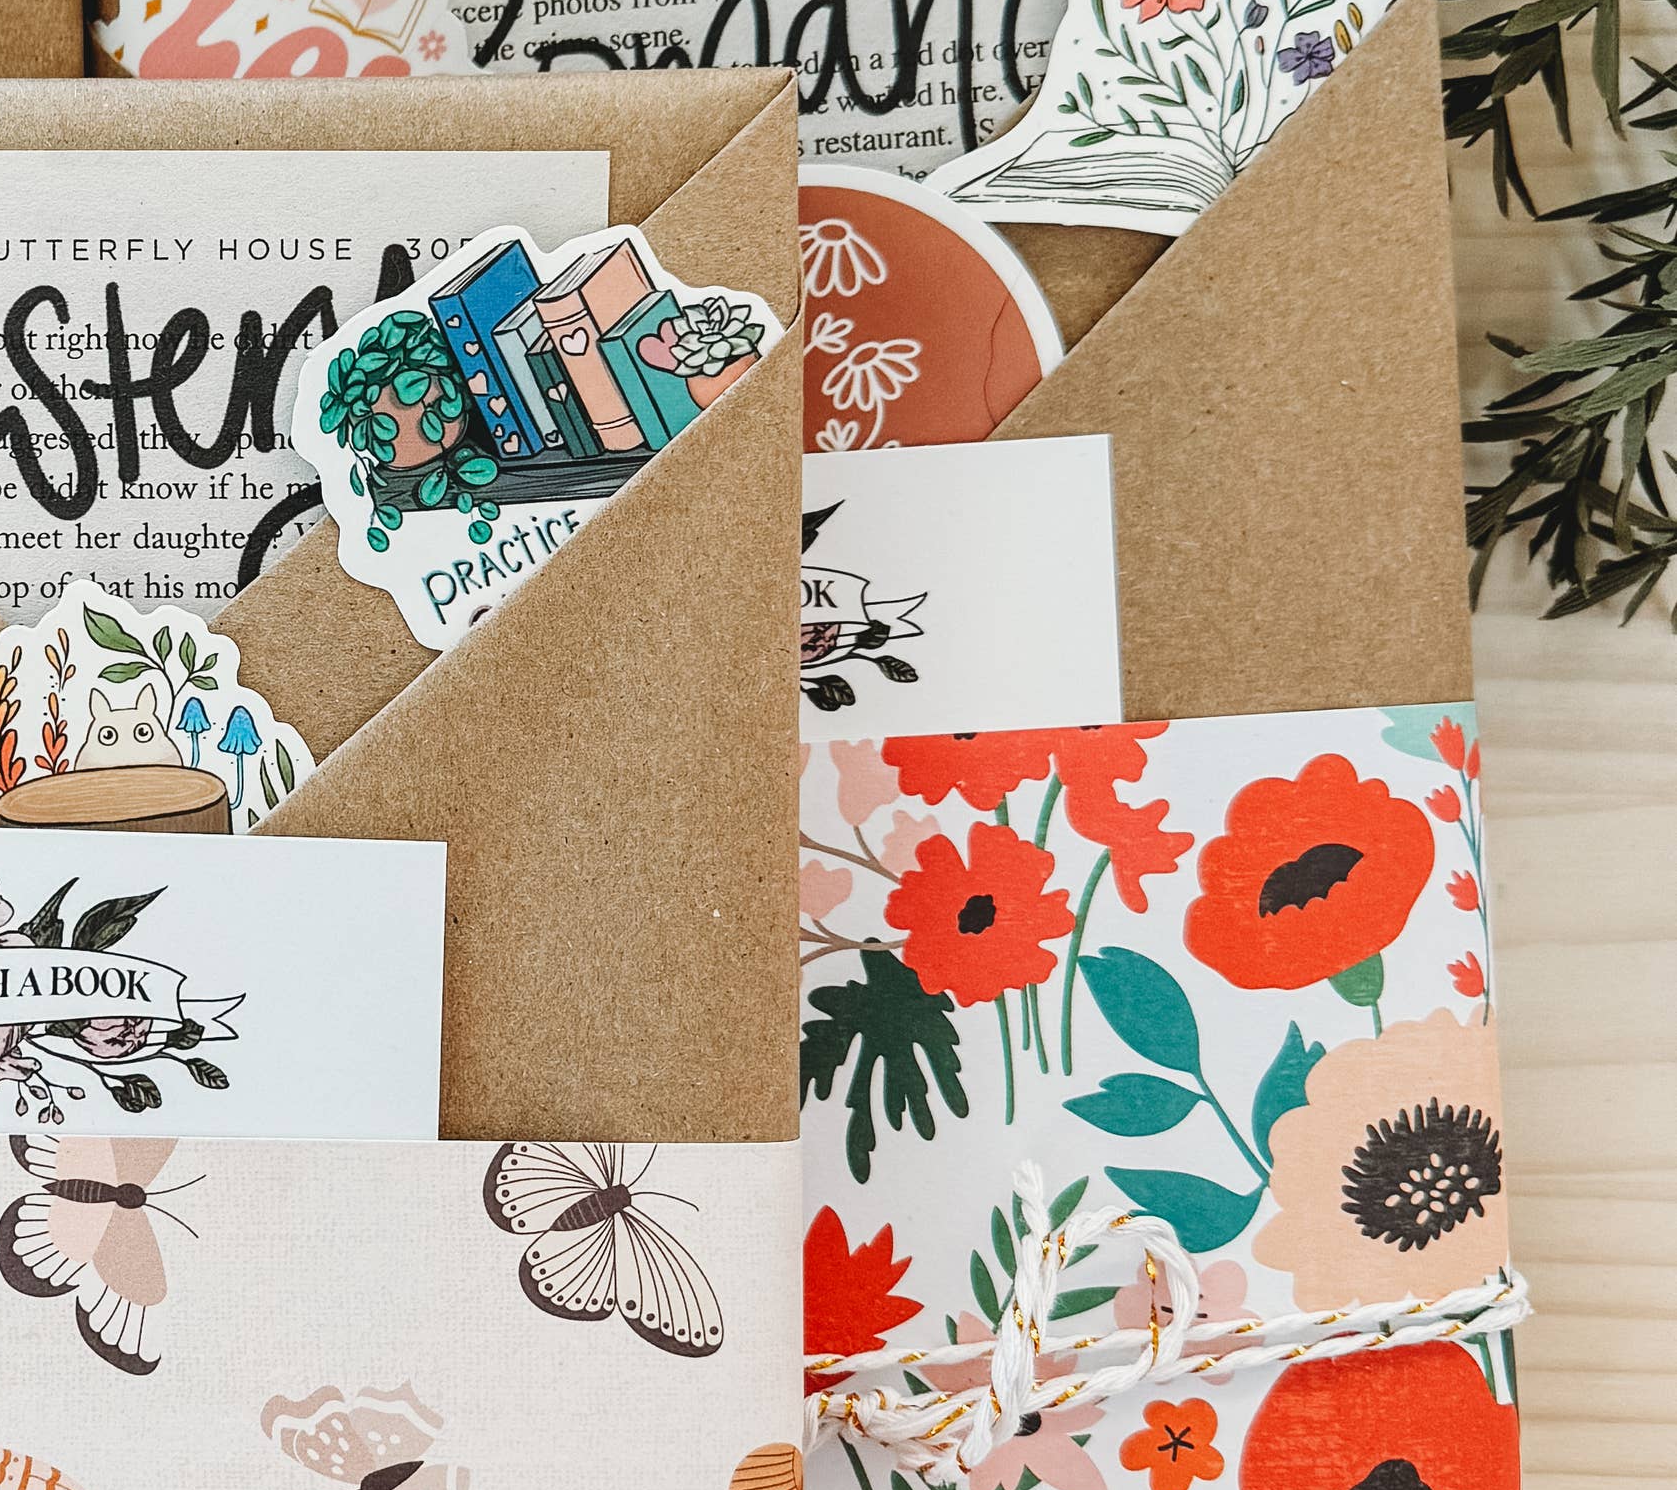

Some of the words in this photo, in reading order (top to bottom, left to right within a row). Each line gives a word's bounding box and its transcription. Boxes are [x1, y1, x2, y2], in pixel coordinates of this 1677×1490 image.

[814, 124, 953, 157] restaurant.
[219, 237, 353, 261] HOUSE
[120, 475, 198, 500] know
[209, 471, 234, 500] if
[240, 472, 274, 500] he
[74, 522, 122, 550] her
[40, 571, 74, 599] of
[143, 572, 184, 599] his
[15, 967, 41, 998] A
[49, 965, 153, 1003] BOOK
